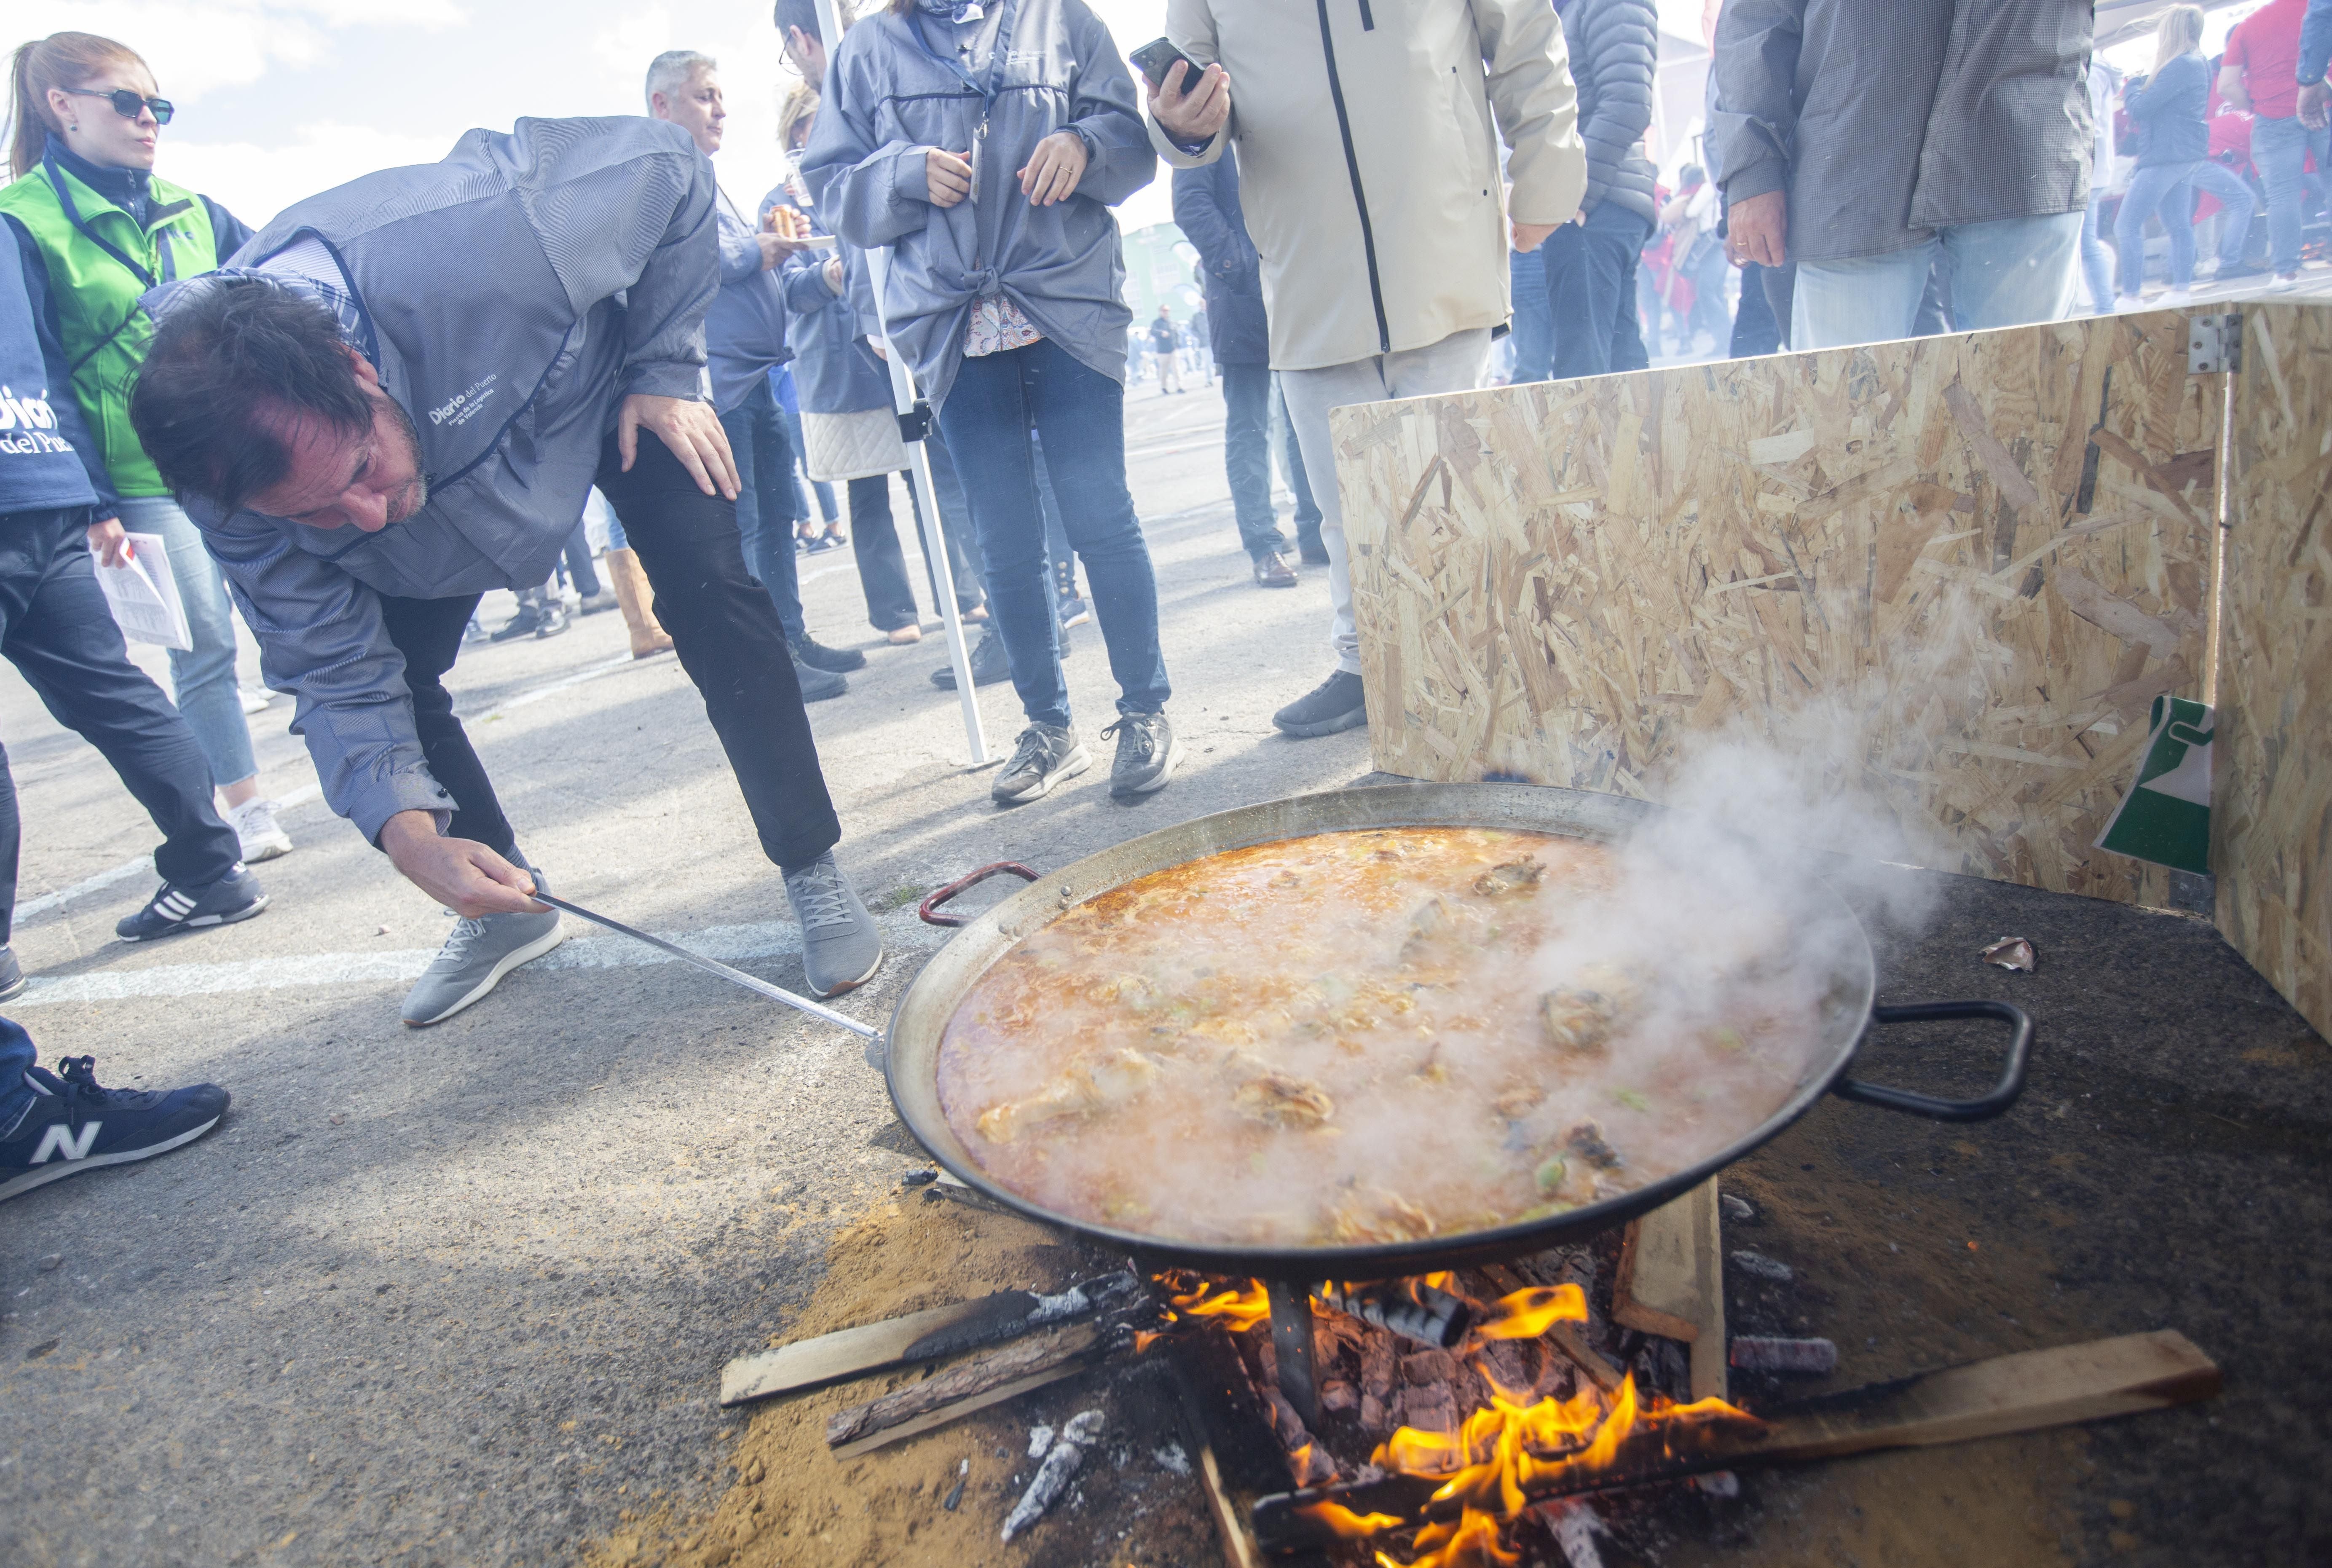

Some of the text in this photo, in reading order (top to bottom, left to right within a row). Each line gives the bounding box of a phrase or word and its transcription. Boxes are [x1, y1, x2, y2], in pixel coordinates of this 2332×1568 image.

[428, 374, 496, 425] Diario del Puerto
[448, 412, 464, 426] Fiesta
[464, 404, 483, 419] Valencia
[0, 431, 41, 454] del
